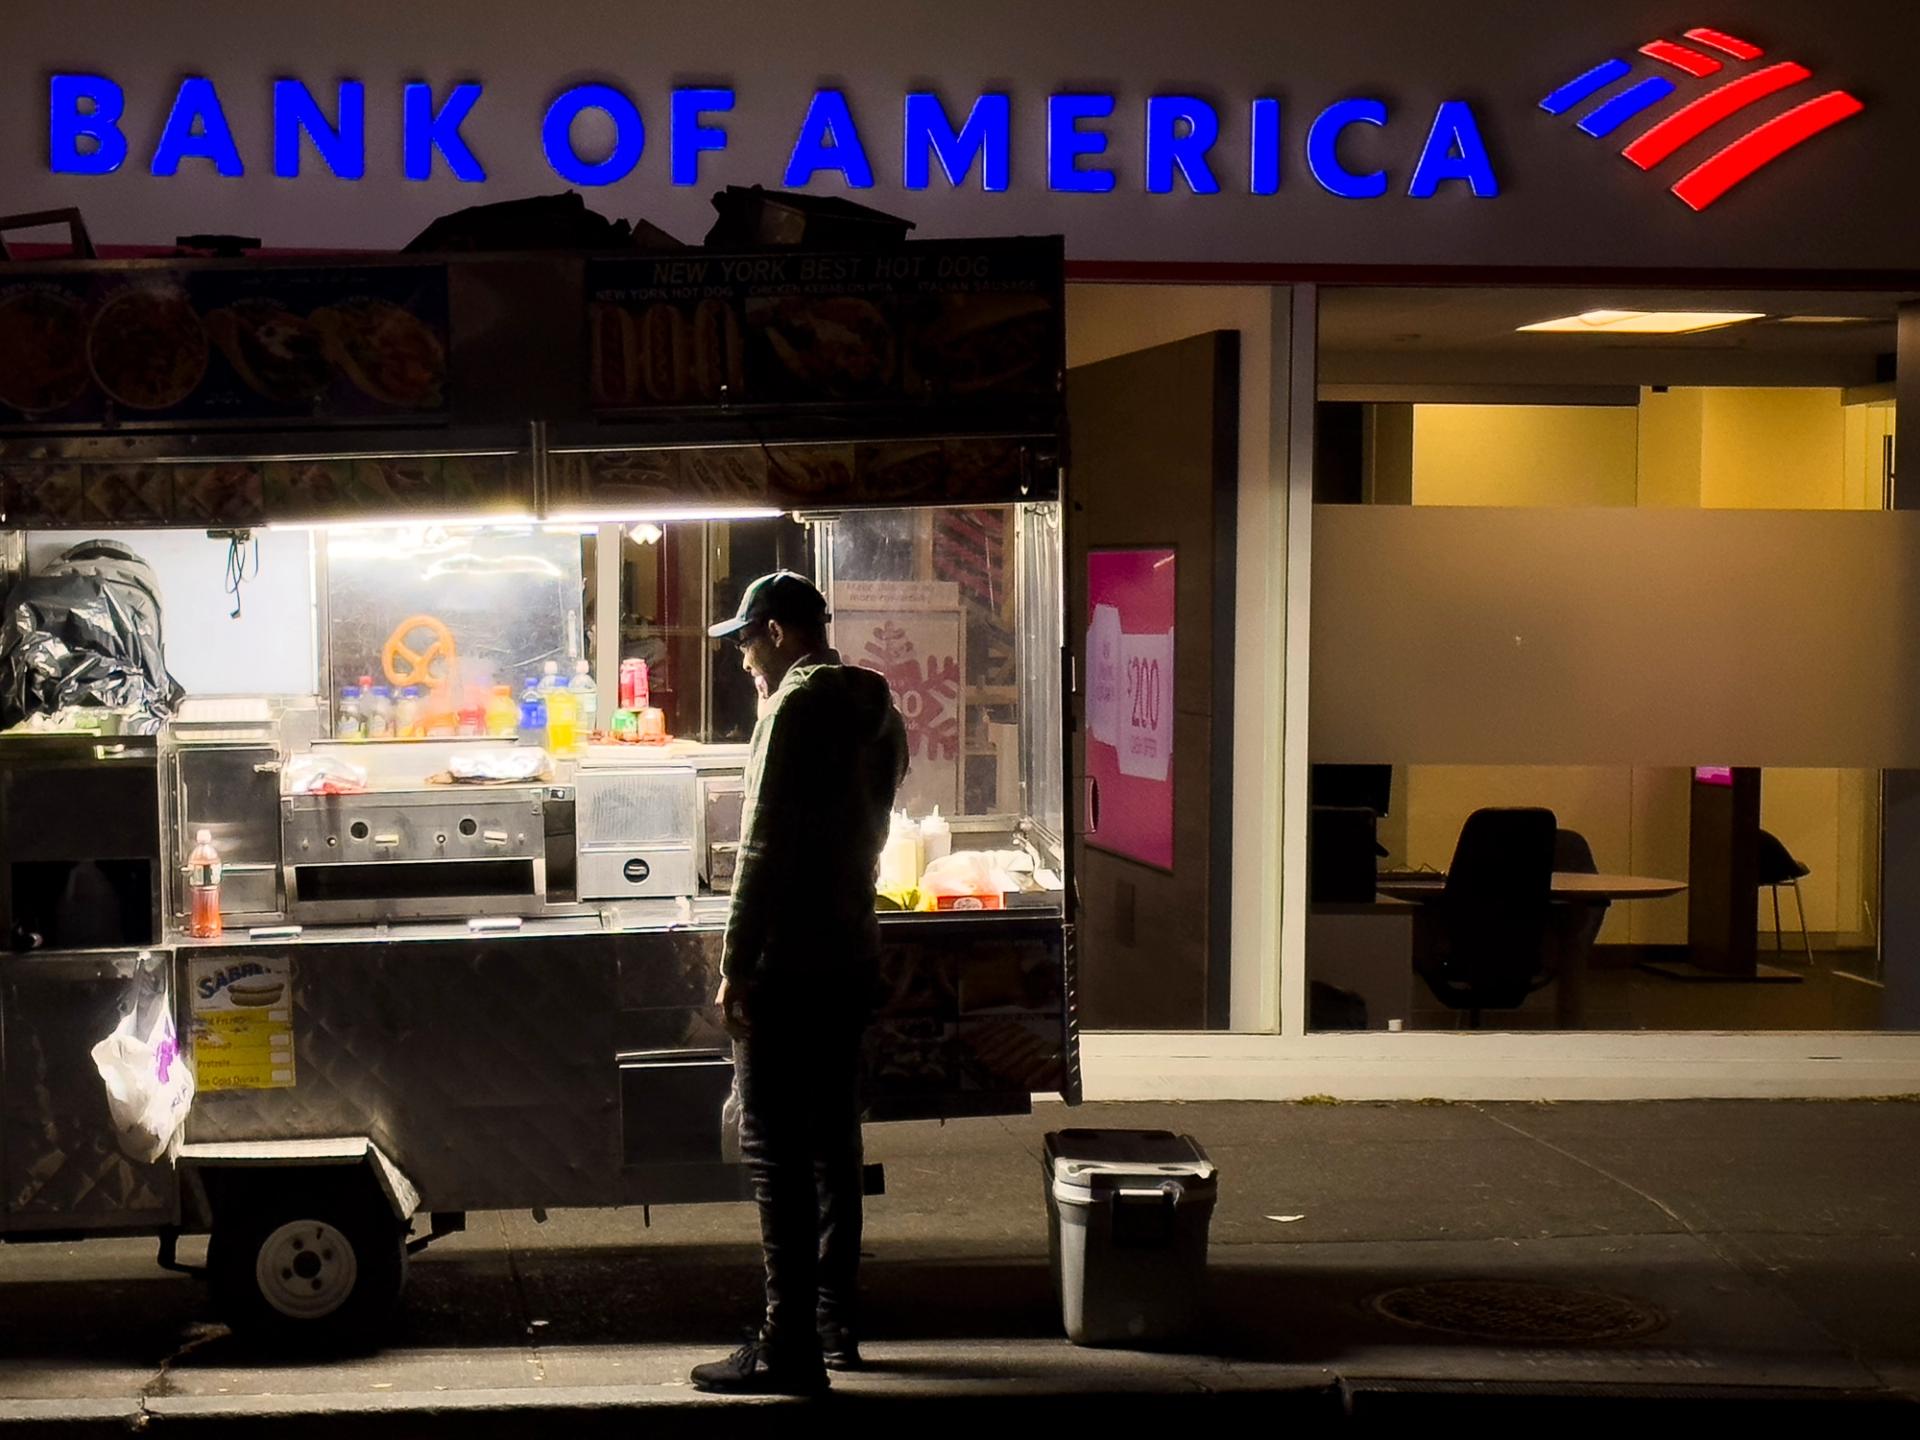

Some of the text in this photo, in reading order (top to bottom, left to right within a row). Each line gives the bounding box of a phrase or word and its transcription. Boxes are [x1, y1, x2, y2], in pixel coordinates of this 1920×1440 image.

[49, 74, 1498, 198] BANK OF AMERICA
[595, 285, 735, 301] NEW YORK HOT DOG
[653, 254, 991, 286] NEW YORK BEST HOT DOG
[1127, 656, 1160, 731] $200
